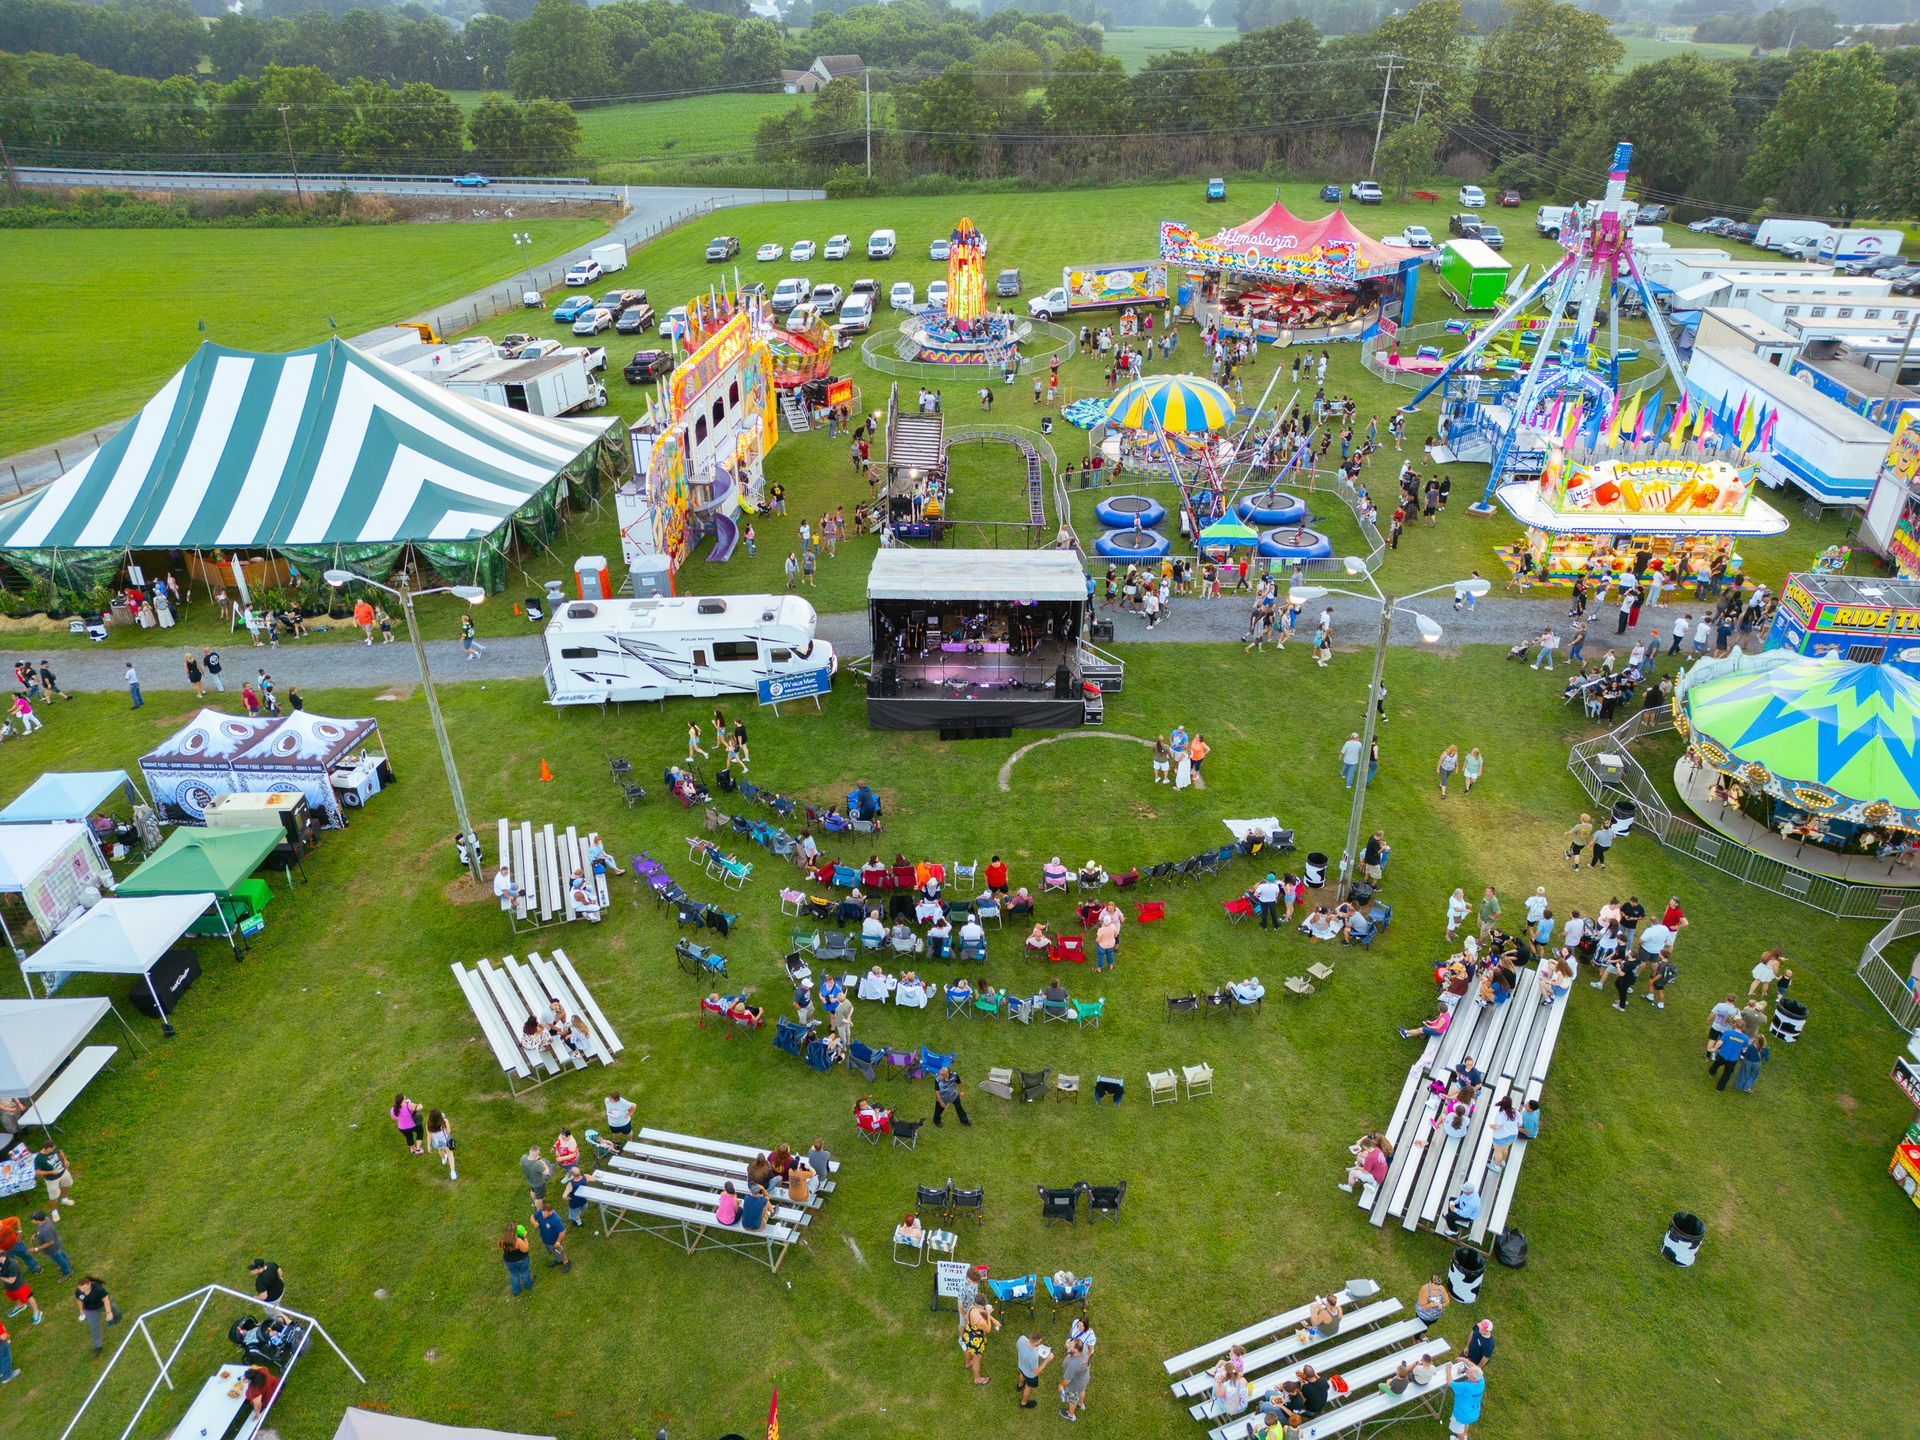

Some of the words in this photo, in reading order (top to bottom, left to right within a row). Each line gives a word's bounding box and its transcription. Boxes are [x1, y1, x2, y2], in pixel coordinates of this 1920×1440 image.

[1612, 460, 1704, 481] POPCORN
[1832, 608, 1893, 629] RIDE
[1896, 611, 1920, 631] TI
[1895, 1070, 1920, 1107] SAUS
